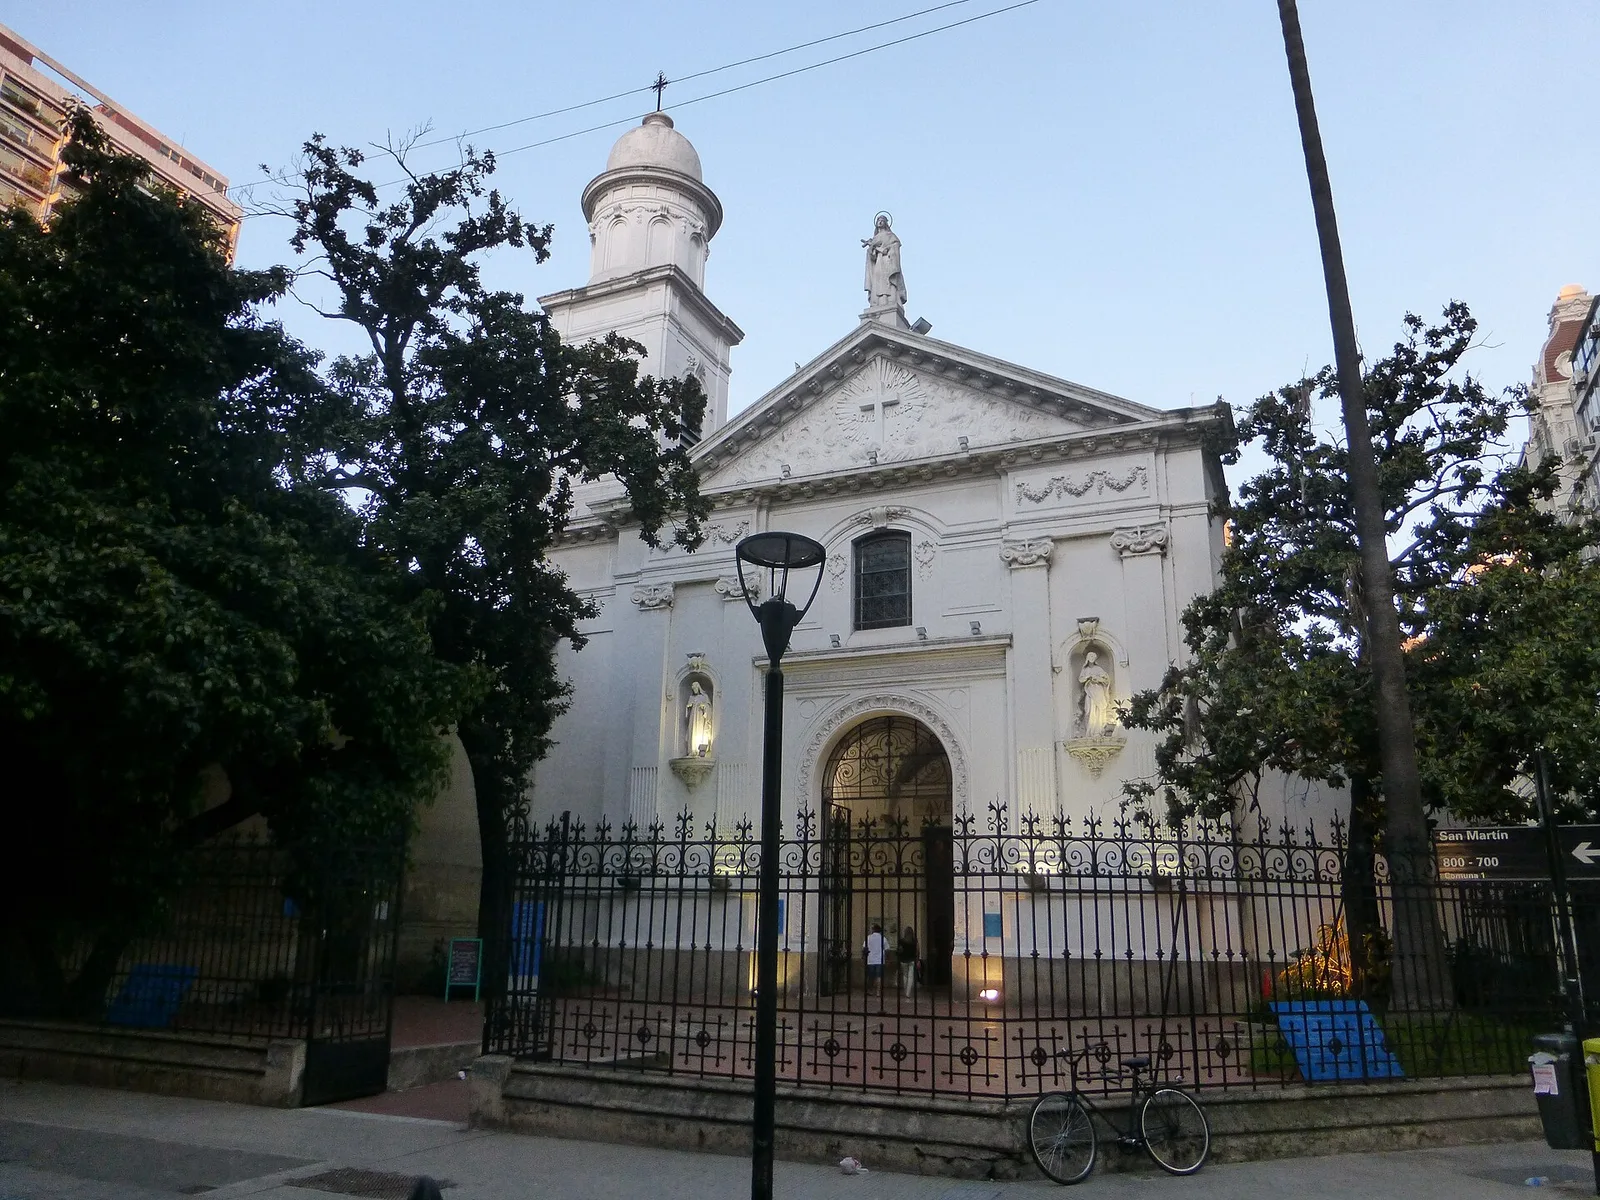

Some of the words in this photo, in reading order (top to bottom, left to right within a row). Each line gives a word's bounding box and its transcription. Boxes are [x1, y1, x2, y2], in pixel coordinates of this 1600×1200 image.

[1439, 831, 1463, 841] San
[1466, 829, 1509, 841] Martín
[1443, 857, 1465, 867] 800
[1476, 857, 1499, 867] 700
